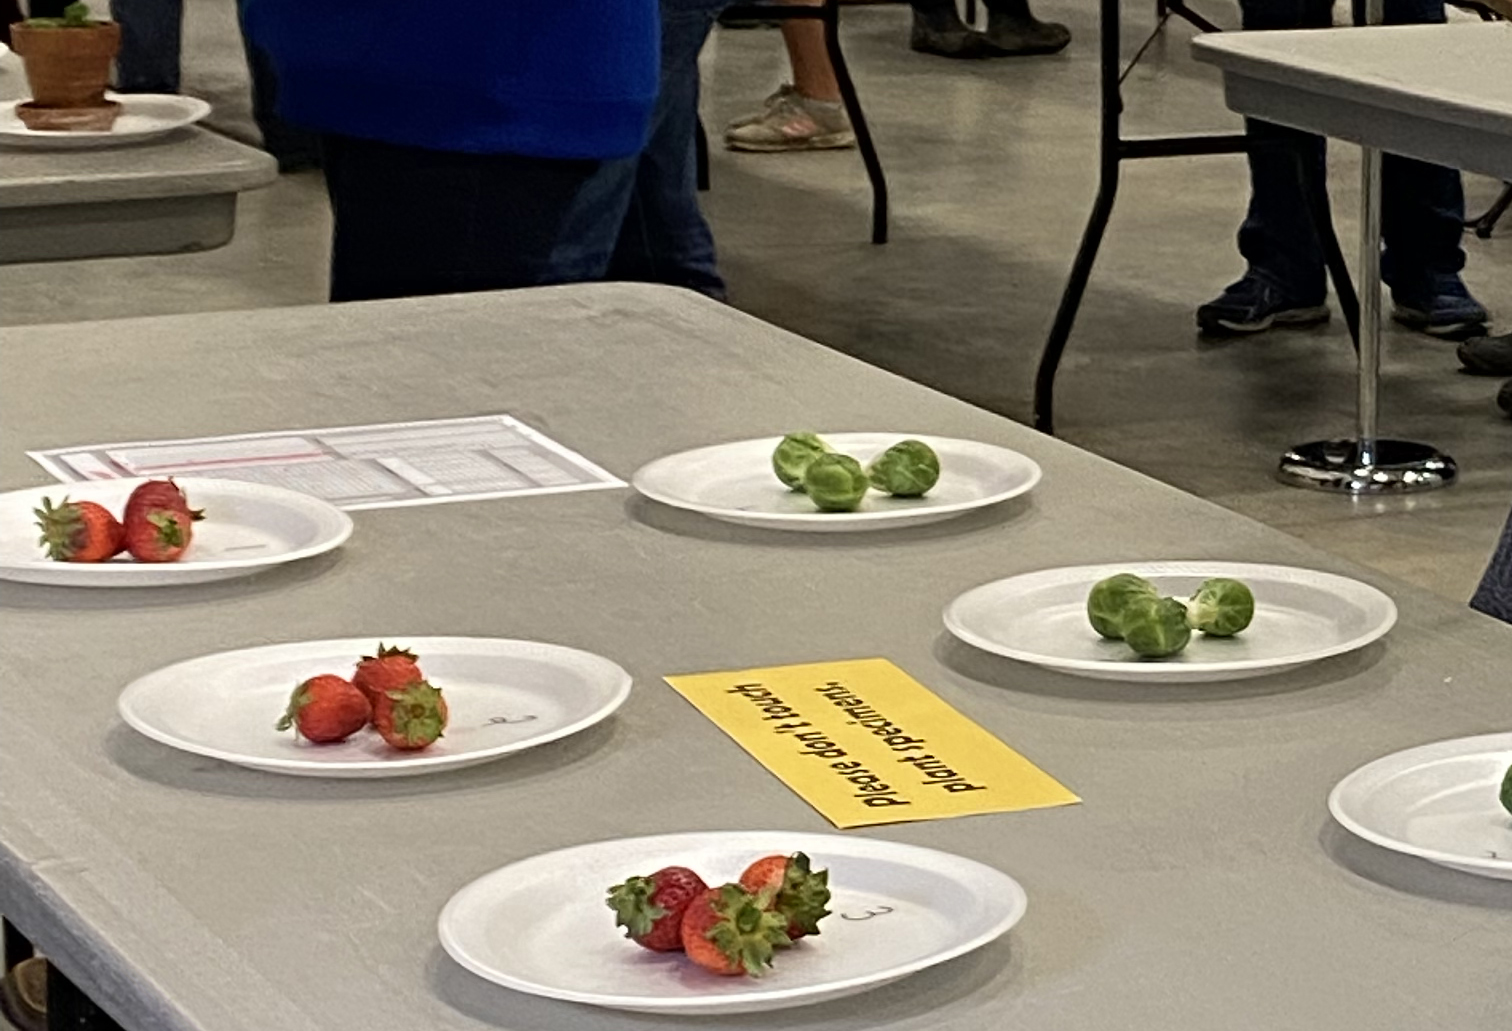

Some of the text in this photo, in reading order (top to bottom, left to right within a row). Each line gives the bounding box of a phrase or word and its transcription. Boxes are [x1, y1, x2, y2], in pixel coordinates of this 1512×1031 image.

[726, 683, 912, 807] Please don't touch
[897, 755, 987, 793] plant
[840, 905, 895, 921] 3
